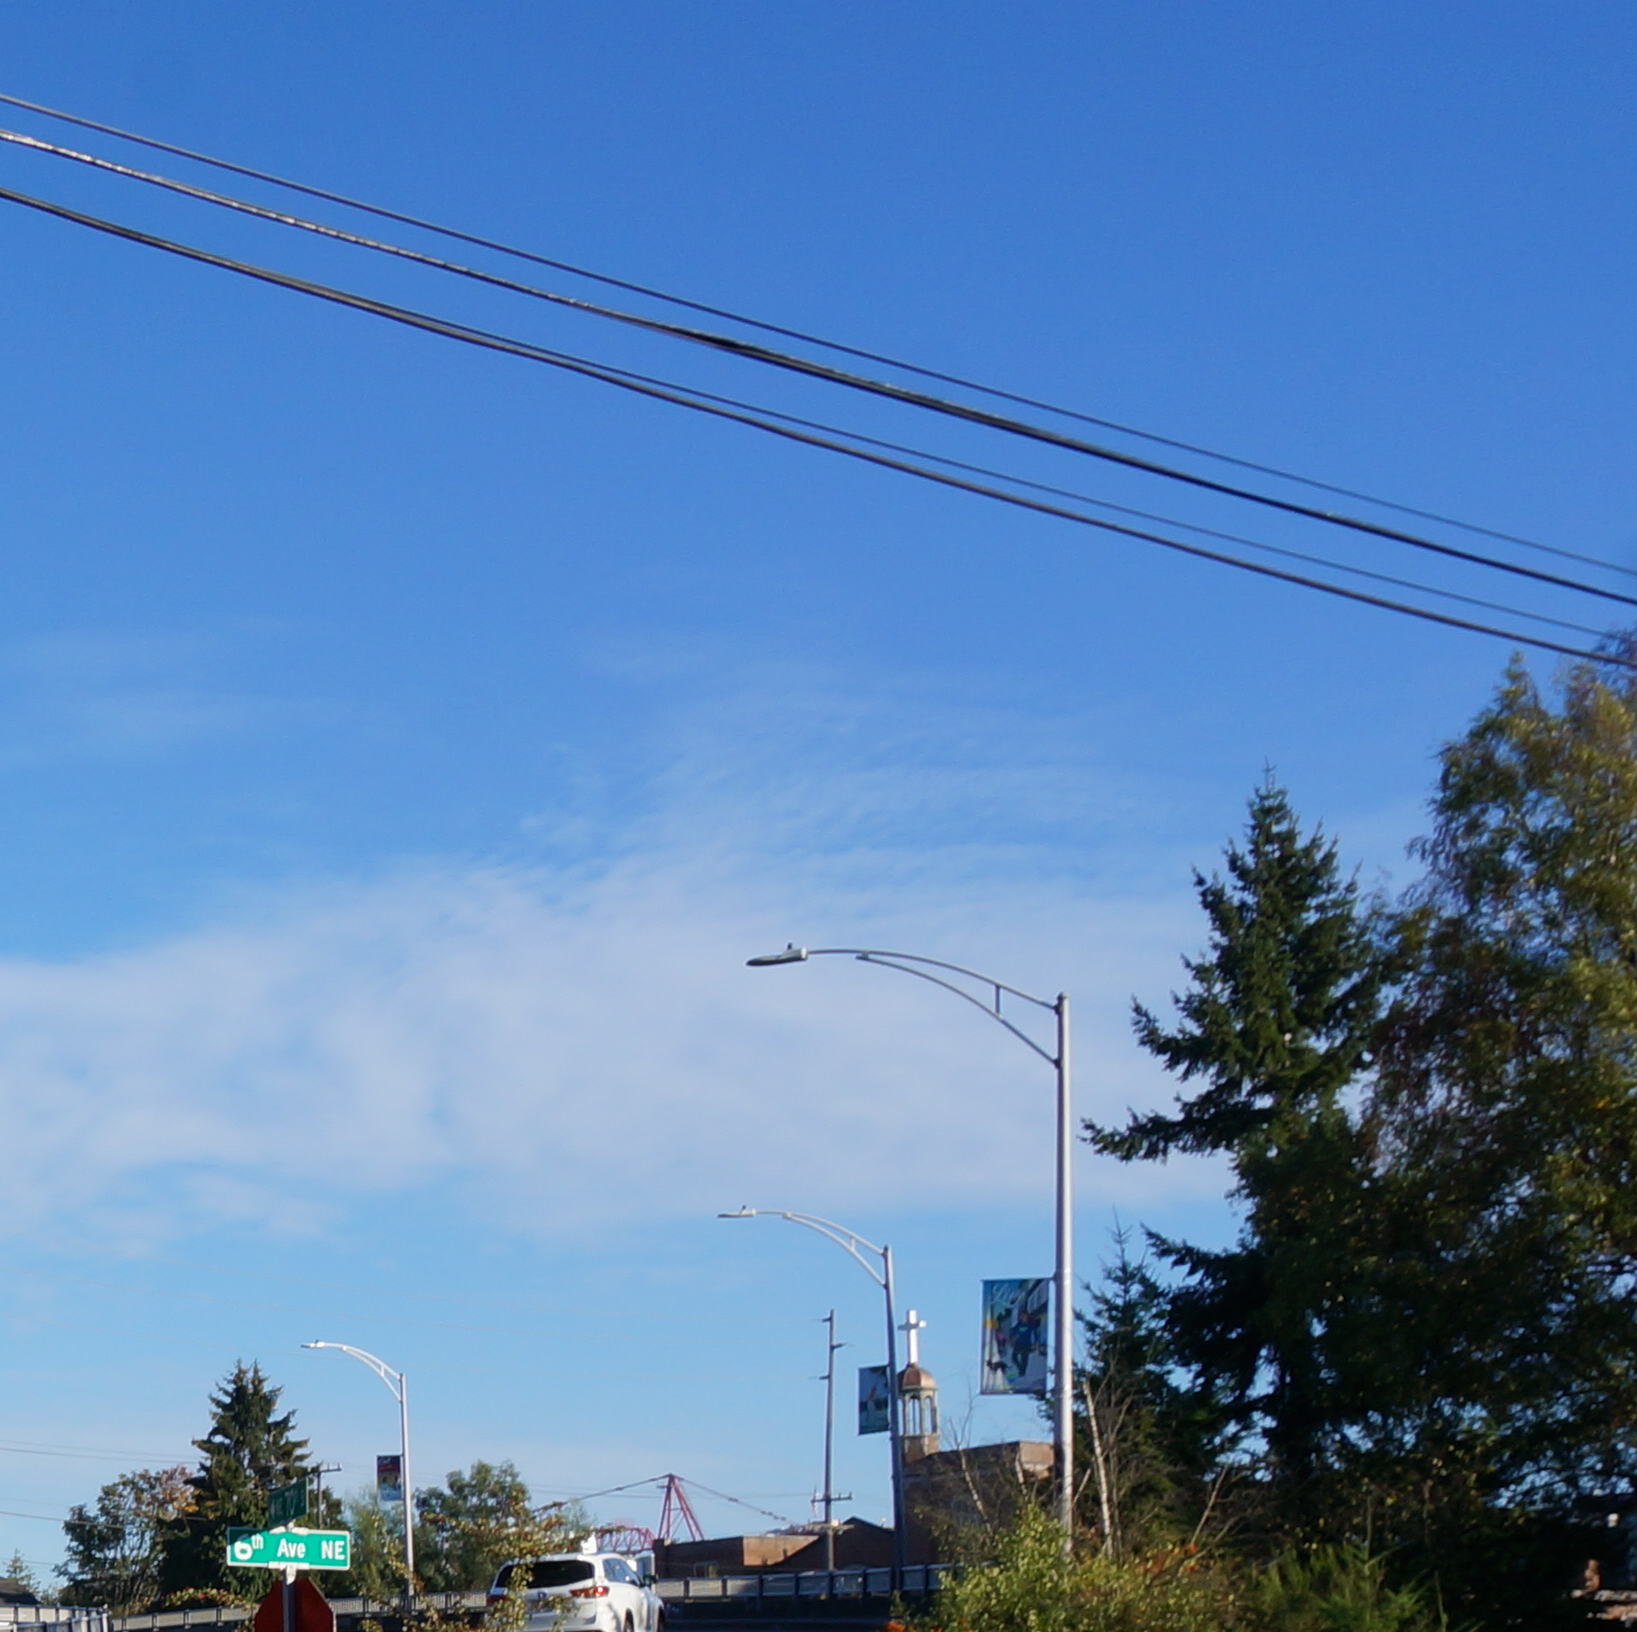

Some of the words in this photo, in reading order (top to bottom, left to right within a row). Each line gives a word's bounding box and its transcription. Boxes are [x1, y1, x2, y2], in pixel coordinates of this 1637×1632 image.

[234, 1533, 264, 1561] 6th
[276, 1538, 306, 1559] Ave
[321, 1540, 346, 1561] NE
